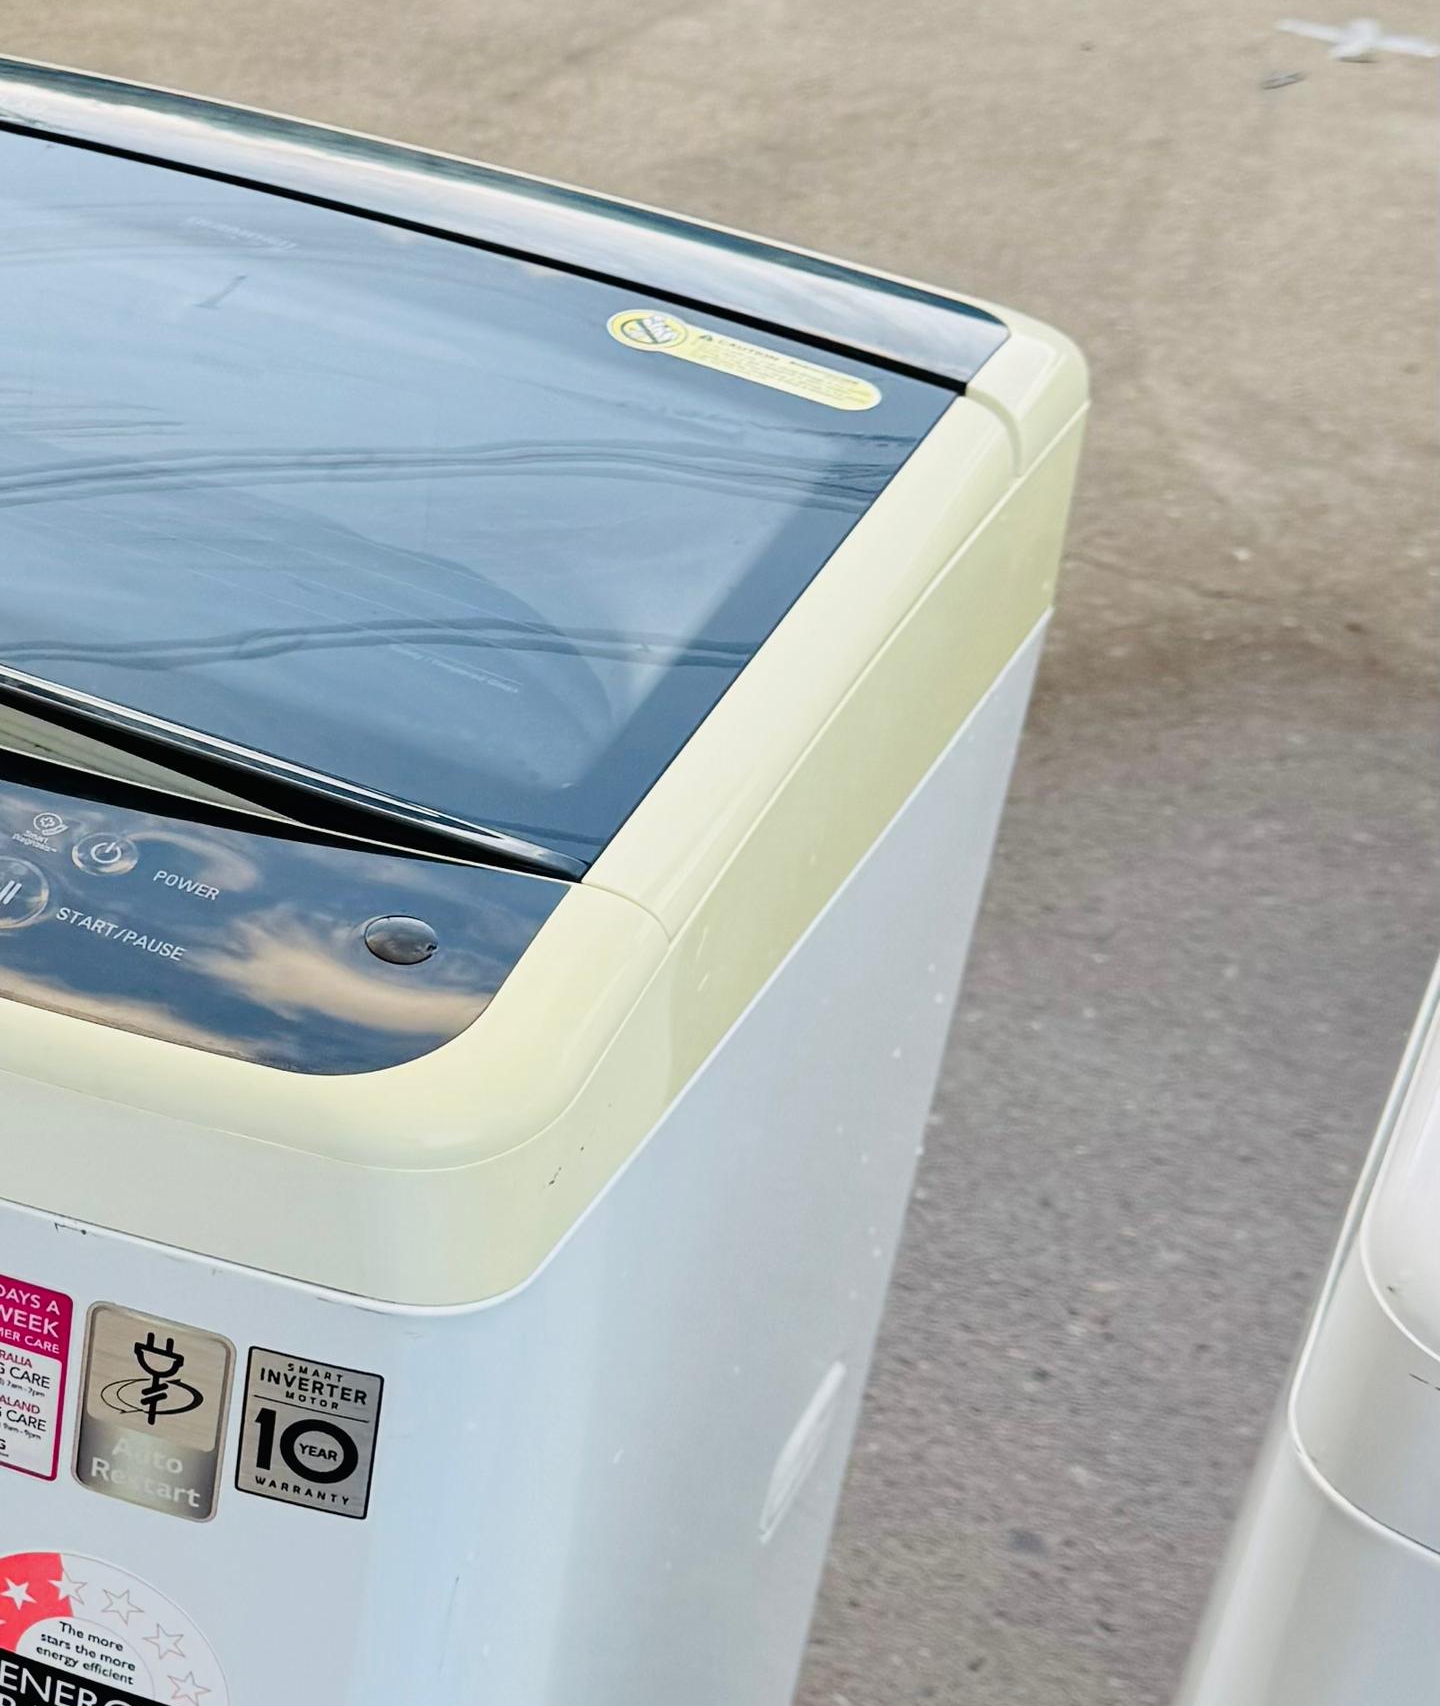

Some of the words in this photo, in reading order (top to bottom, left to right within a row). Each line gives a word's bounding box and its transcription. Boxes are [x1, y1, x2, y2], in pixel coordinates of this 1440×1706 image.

[22, 830, 48, 844] Smart
[153, 870, 220, 901] POWER
[56, 907, 187, 961] START/PAUSE
[46, 1300, 60, 1316] A
[24, 1335, 60, 1354] CARE
[10, 1367, 50, 1389] CARE
[260, 1368, 368, 1406] INVERTER
[287, 1363, 344, 1383] SMART
[286, 1391, 340, 1411] MOTOR
[6, 1410, 47, 1432] CARE
[254, 1407, 359, 1484] 10
[299, 1443, 338, 1462] YEAR
[91, 1456, 201, 1508] Restart
[255, 1475, 350, 1506] WARRANTY
[59, 1621, 84, 1639] The
[88, 1633, 124, 1652] more
[36, 1646, 79, 1668] energy
[83, 1660, 134, 1685] efficient
[41, 1633, 71, 1650] stars
[75, 1644, 97, 1659] the
[100, 1654, 136, 1672] more
